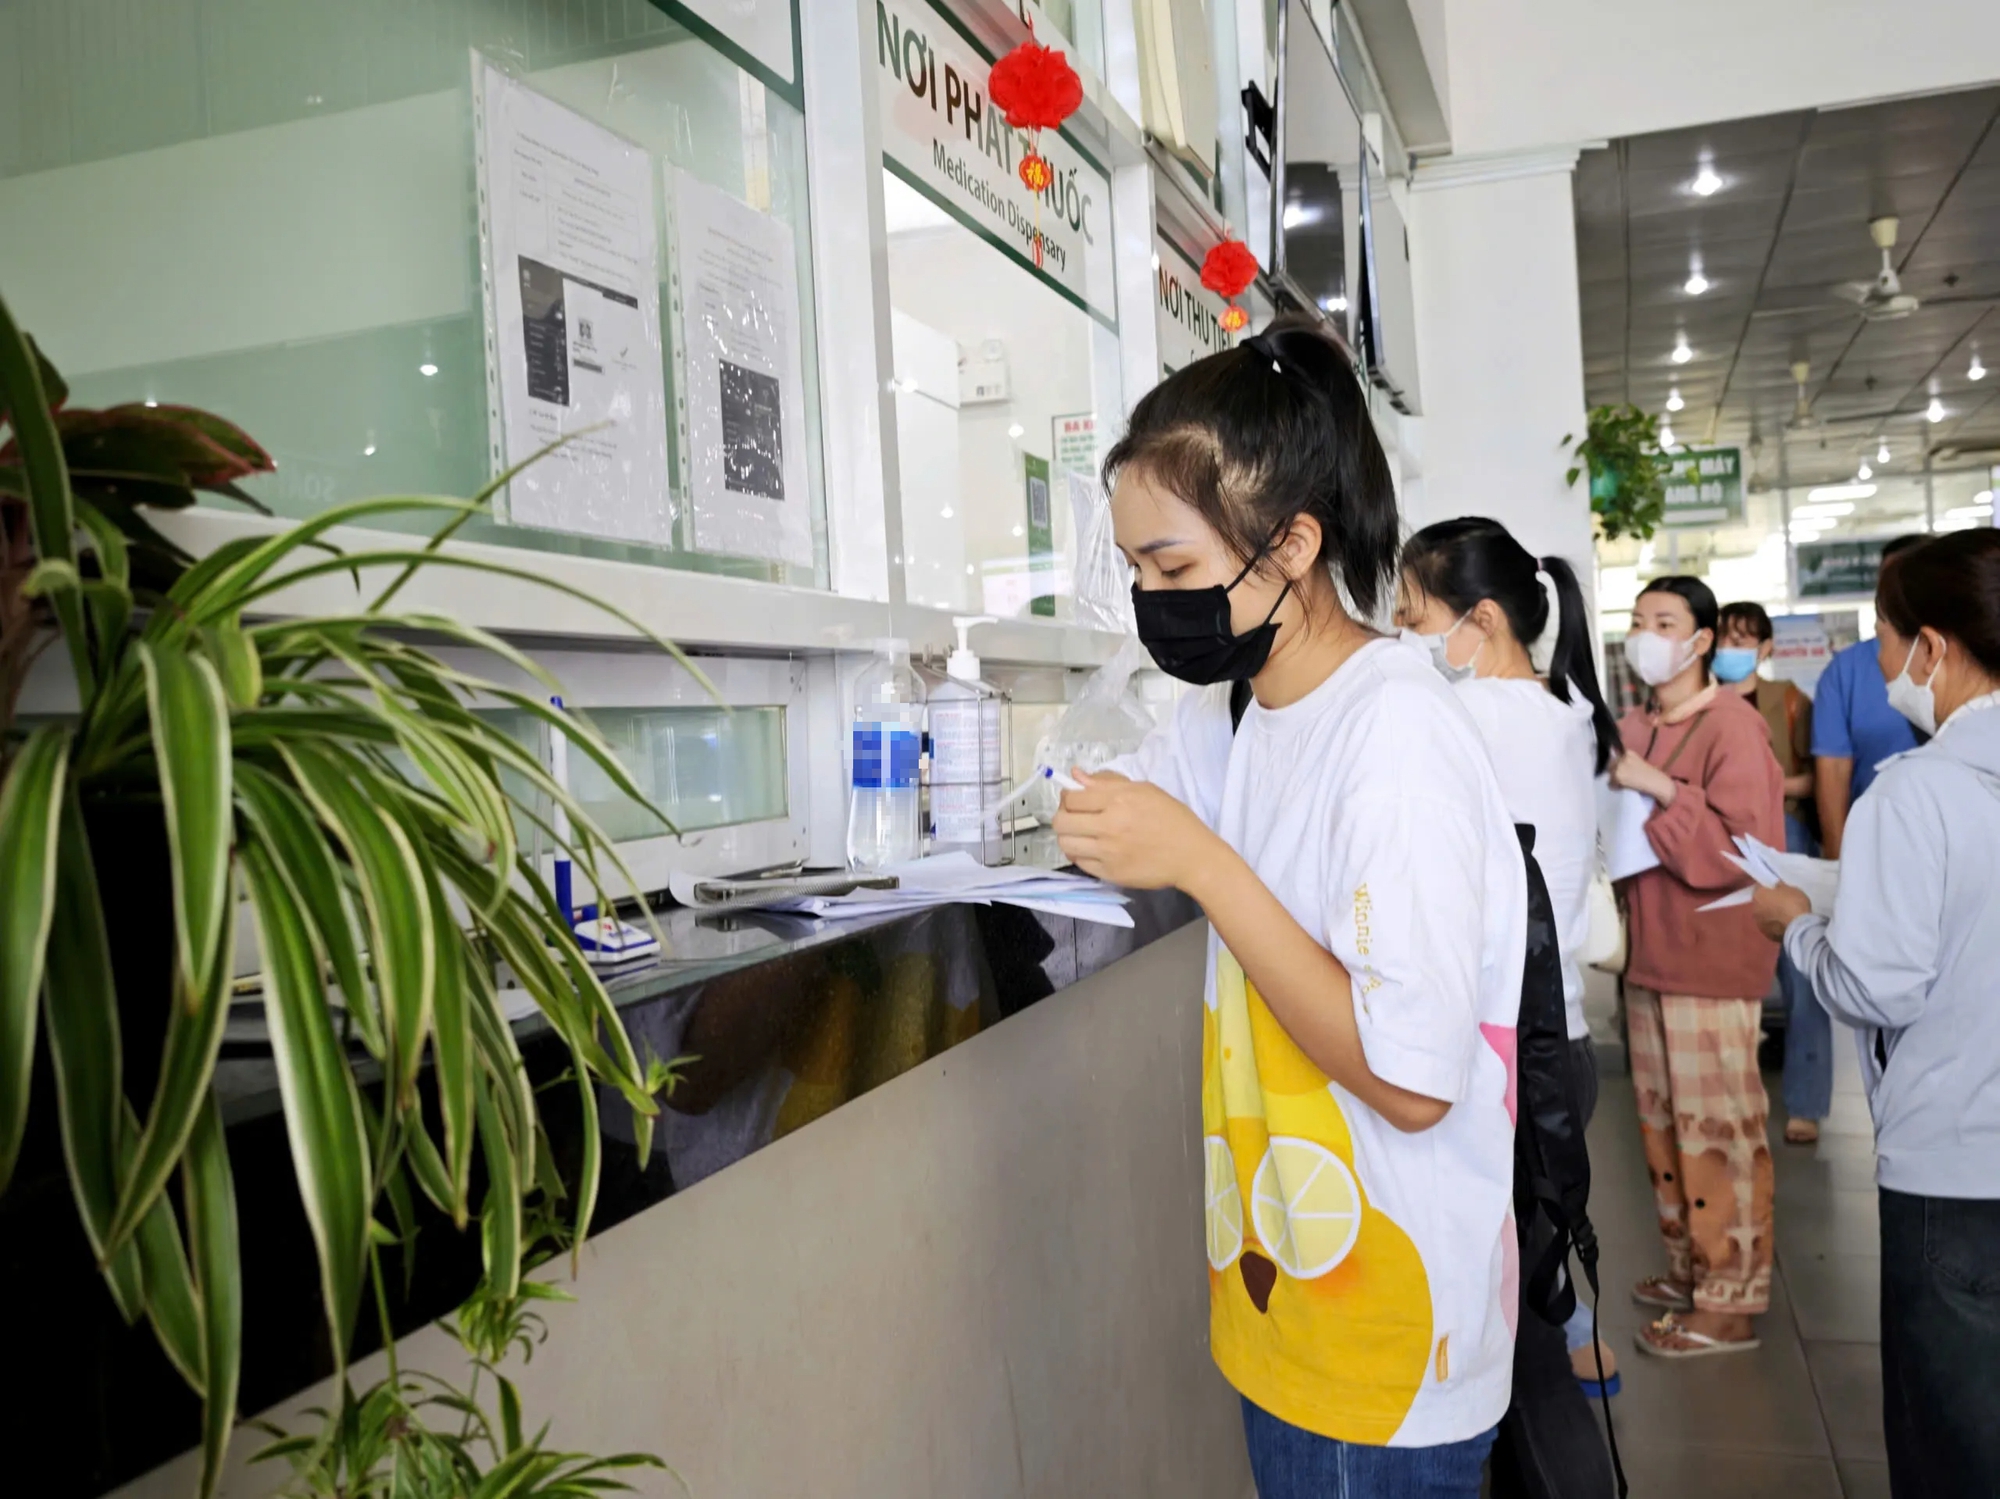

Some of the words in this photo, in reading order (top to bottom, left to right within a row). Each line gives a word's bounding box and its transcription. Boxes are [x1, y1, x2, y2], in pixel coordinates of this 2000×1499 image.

[877, 0, 937, 112] NƠI
[933, 137, 1006, 221] Medication
[1009, 198, 1066, 273] Dispensary
[1159, 262, 1183, 325] NƠI
[1184, 287, 1210, 346] THU
